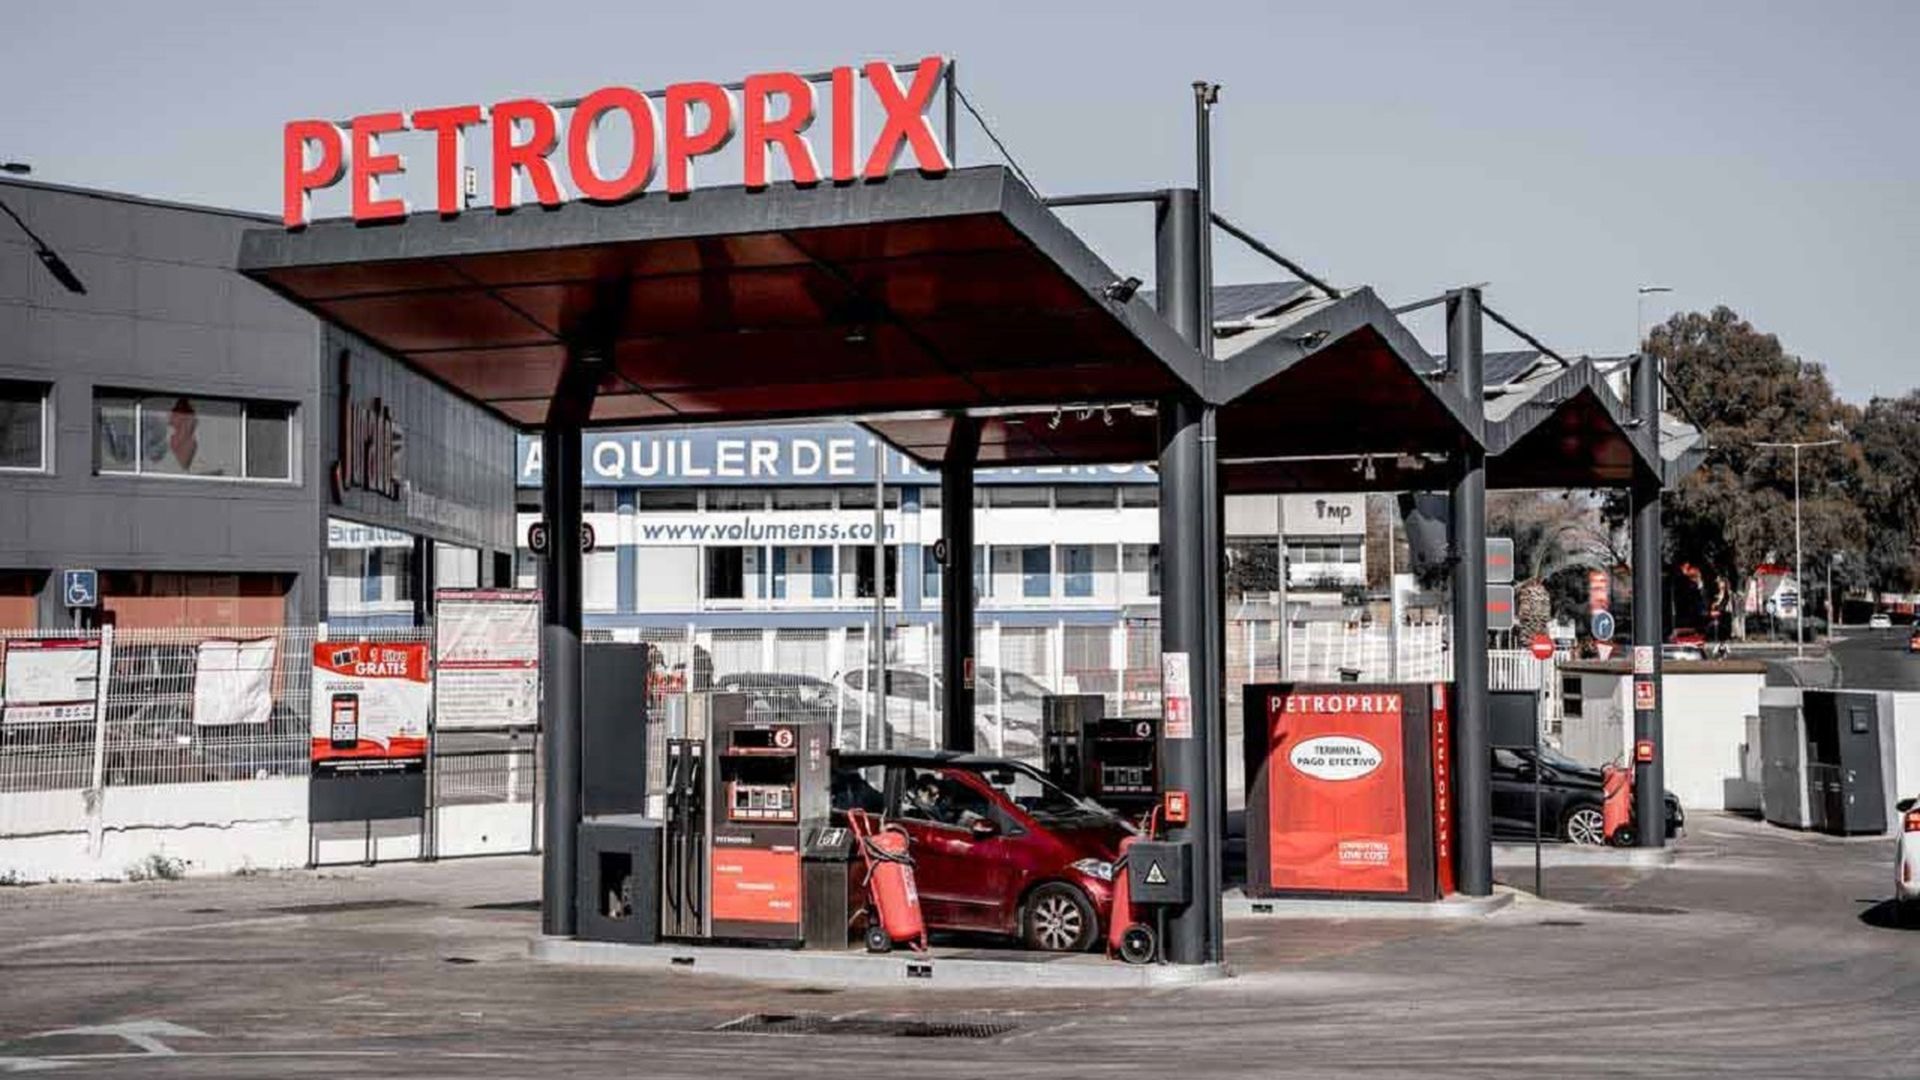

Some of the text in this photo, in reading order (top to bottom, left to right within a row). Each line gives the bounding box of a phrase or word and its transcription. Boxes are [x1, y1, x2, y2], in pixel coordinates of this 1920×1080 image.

[283, 56, 953, 229] PETROPRIX
[524, 440, 779, 478] AQUILER
[355, 662, 407, 675] GRATIS
[1271, 695, 1400, 713] PETROPRIX
[1314, 745, 1362, 755] TERMINAL
[1297, 757, 1377, 767] PAGO EFECTIVO
